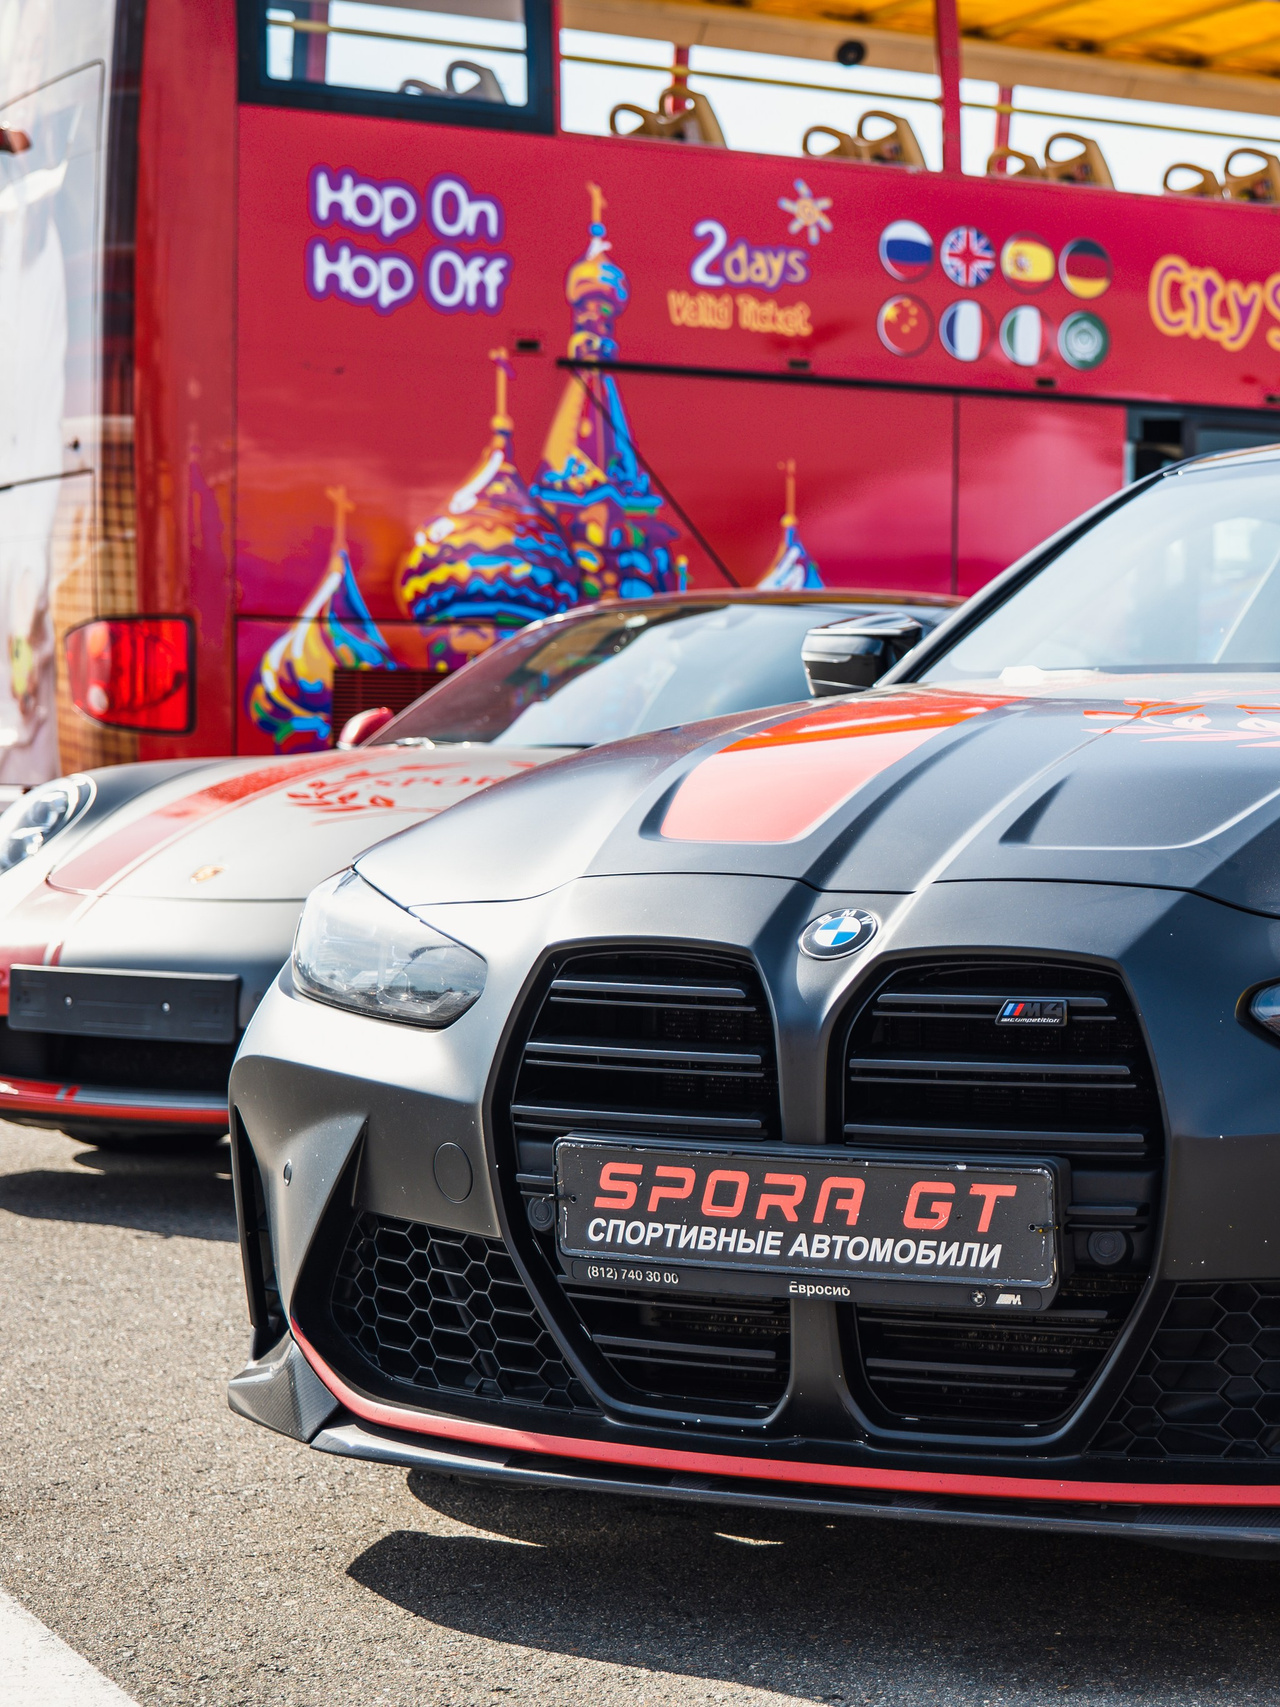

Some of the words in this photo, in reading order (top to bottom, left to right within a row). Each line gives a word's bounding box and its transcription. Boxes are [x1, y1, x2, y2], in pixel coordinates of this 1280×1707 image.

[312, 168, 418, 240] Hop
[428, 175, 502, 242] On
[309, 239, 416, 312] Hop
[424, 246, 510, 312] Off
[1150, 254, 1262, 351] City
[817, 909, 874, 926] BMW
[1017, 1003, 1063, 1017] M4
[592, 1161, 867, 1227] SPORA
[902, 1180, 1018, 1234] GT
[586, 1217, 784, 1258] СПОРТИВНЫЕ
[787, 1231, 1003, 1270] АВТОМОБИЛИ
[587, 1265, 618, 1281] (812)
[621, 1267, 643, 1281] 740
[645, 1269, 661, 1283] 30
[663, 1271, 679, 1284] 00
